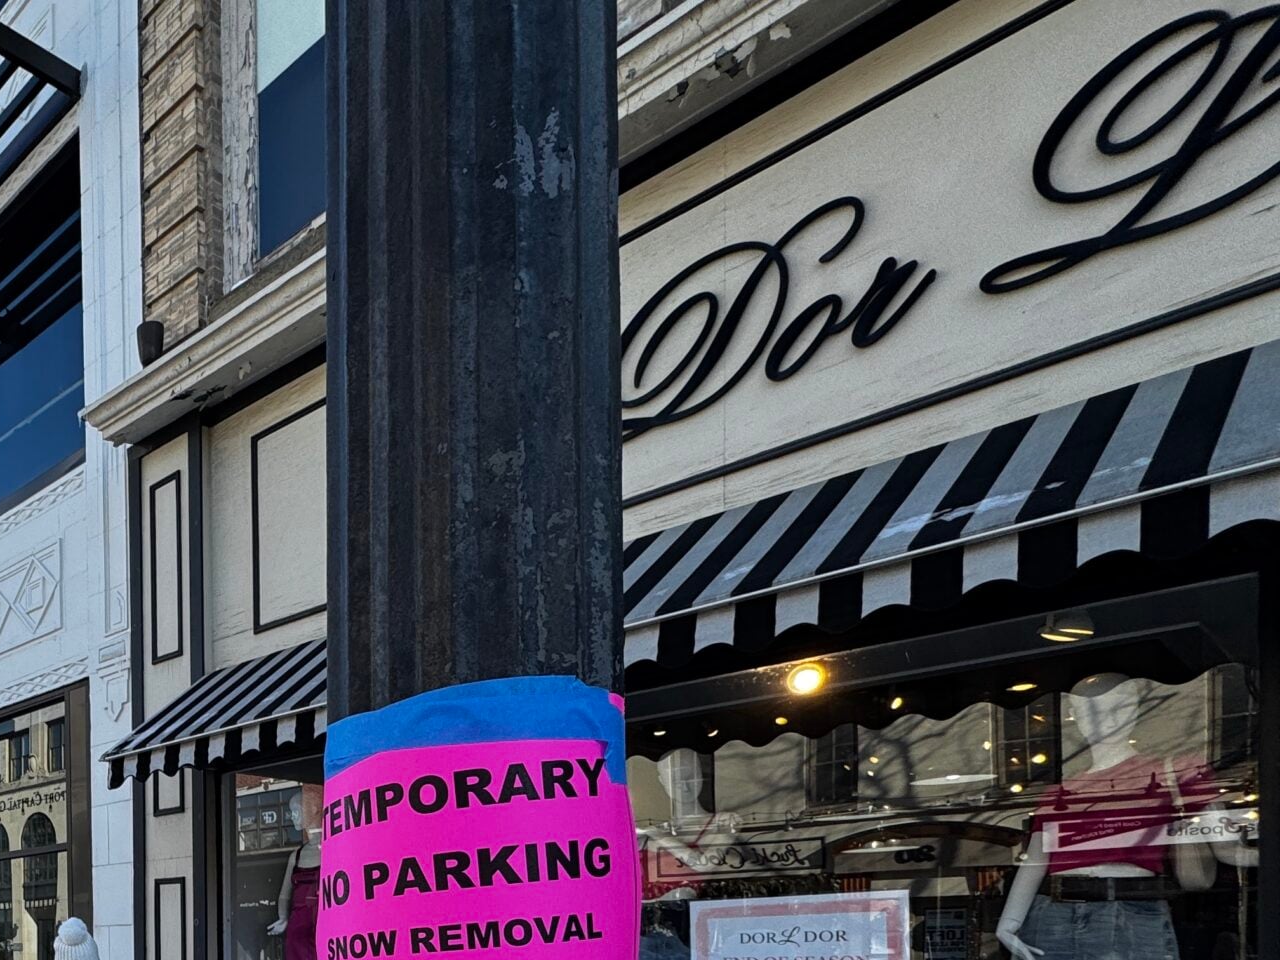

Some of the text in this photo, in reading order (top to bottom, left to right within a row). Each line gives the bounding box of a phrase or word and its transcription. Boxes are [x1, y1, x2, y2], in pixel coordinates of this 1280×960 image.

[621, 196, 937, 441] Dor
[322, 758, 607, 841] TEMPORARY
[322, 838, 612, 911] NO PARKING
[410, 912, 603, 954] REMOVAL
[740, 931, 777, 944] DOR
[804, 929, 848, 943] DOR
